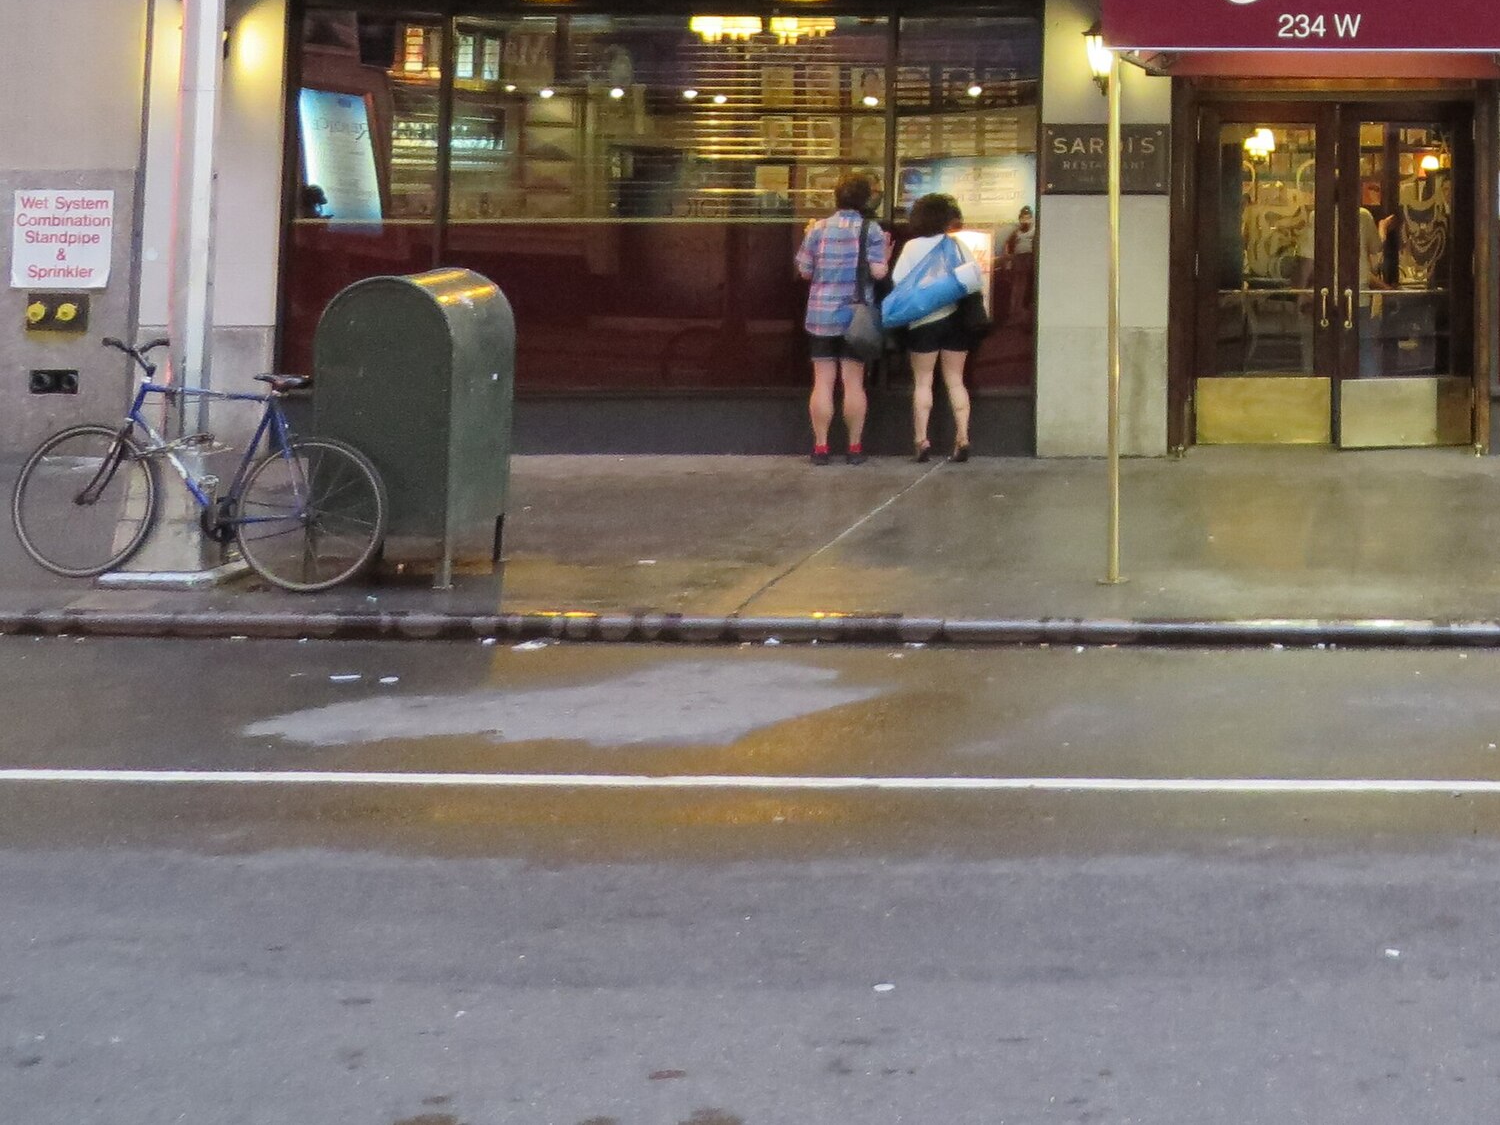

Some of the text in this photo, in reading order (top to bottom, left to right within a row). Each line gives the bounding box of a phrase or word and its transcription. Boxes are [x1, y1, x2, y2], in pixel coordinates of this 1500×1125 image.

[1278, 14, 1361, 38] 234 W
[21, 196, 109, 212] Wet System
[16, 213, 111, 227] Combination
[24, 230, 100, 246] Standpipe
[56, 248, 66, 261] &
[27, 265, 95, 279] Sprinkler
